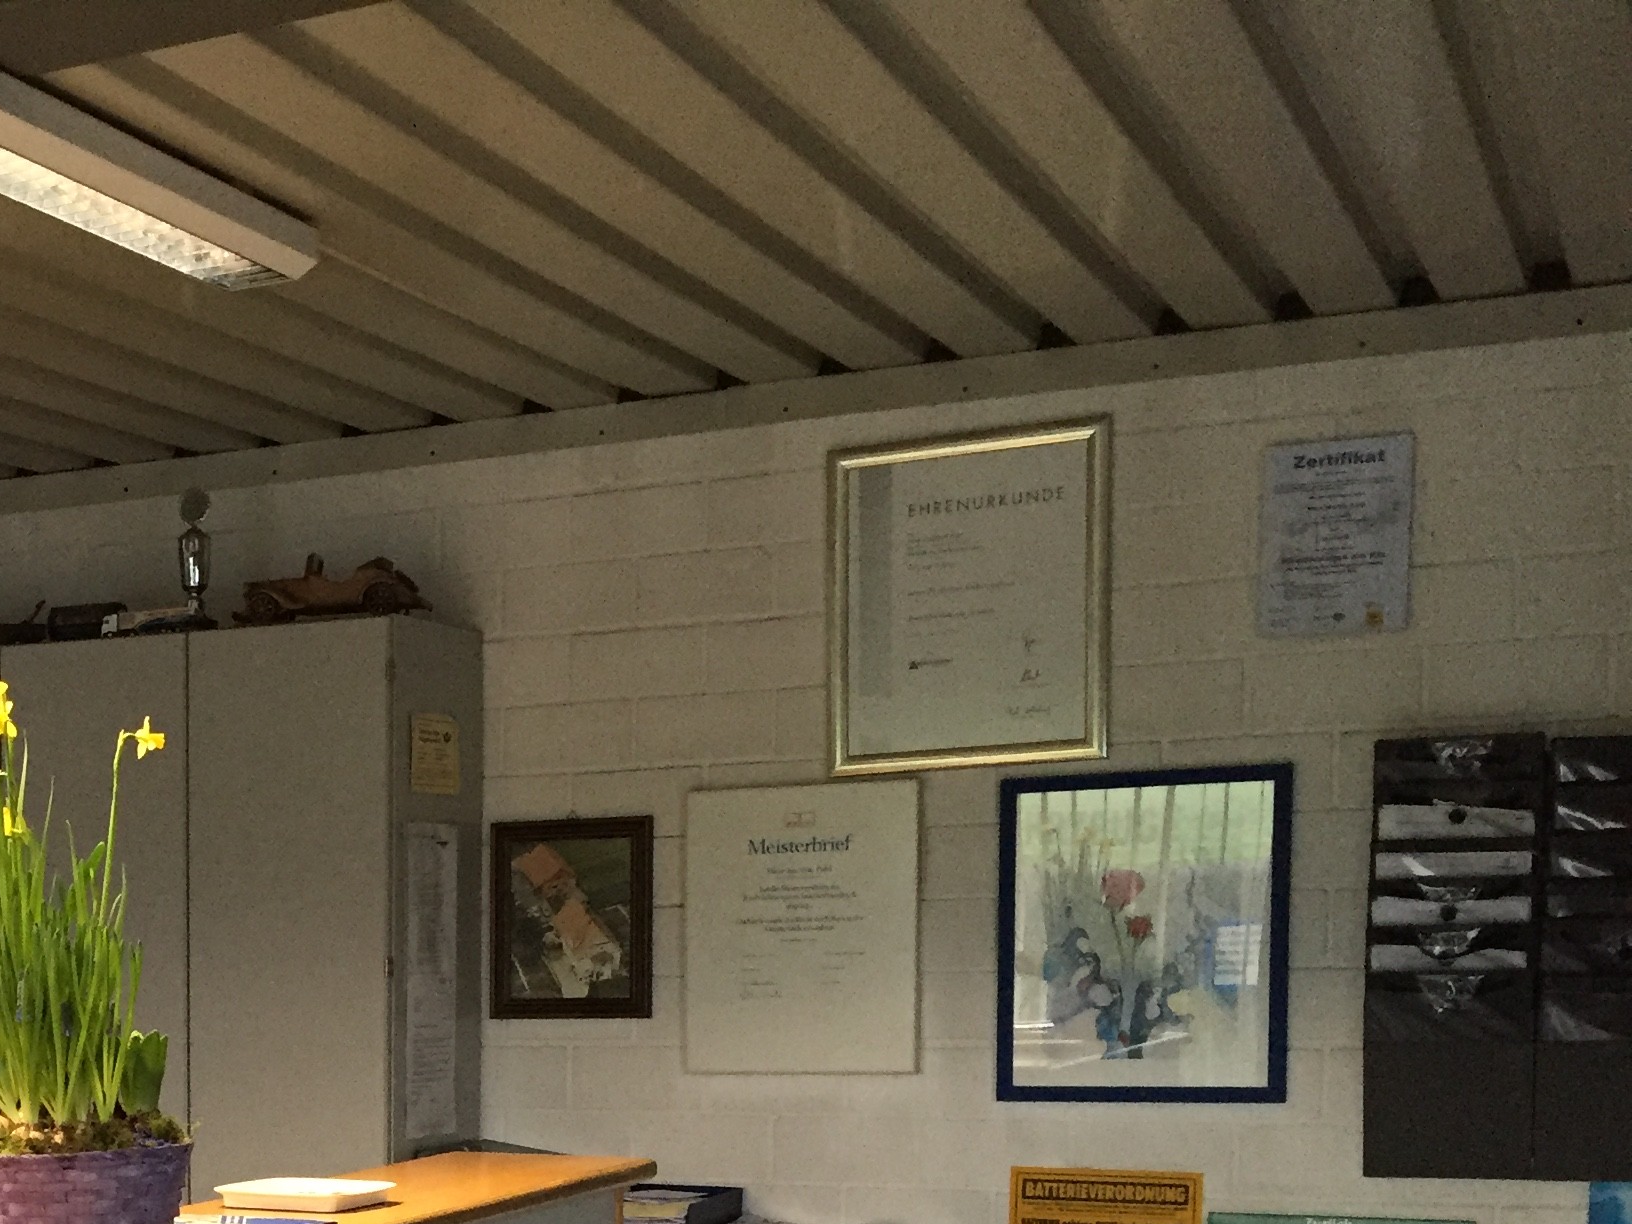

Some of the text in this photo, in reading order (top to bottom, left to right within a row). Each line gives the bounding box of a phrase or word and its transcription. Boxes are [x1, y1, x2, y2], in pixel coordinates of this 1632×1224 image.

[1293, 449, 1386, 469] Zertifikat
[907, 486, 1065, 518] EHRENURKUNDE
[747, 833, 853, 856] Meisterbrief
[1025, 1181, 1187, 1204] BATTERIEVERORDNUNG
